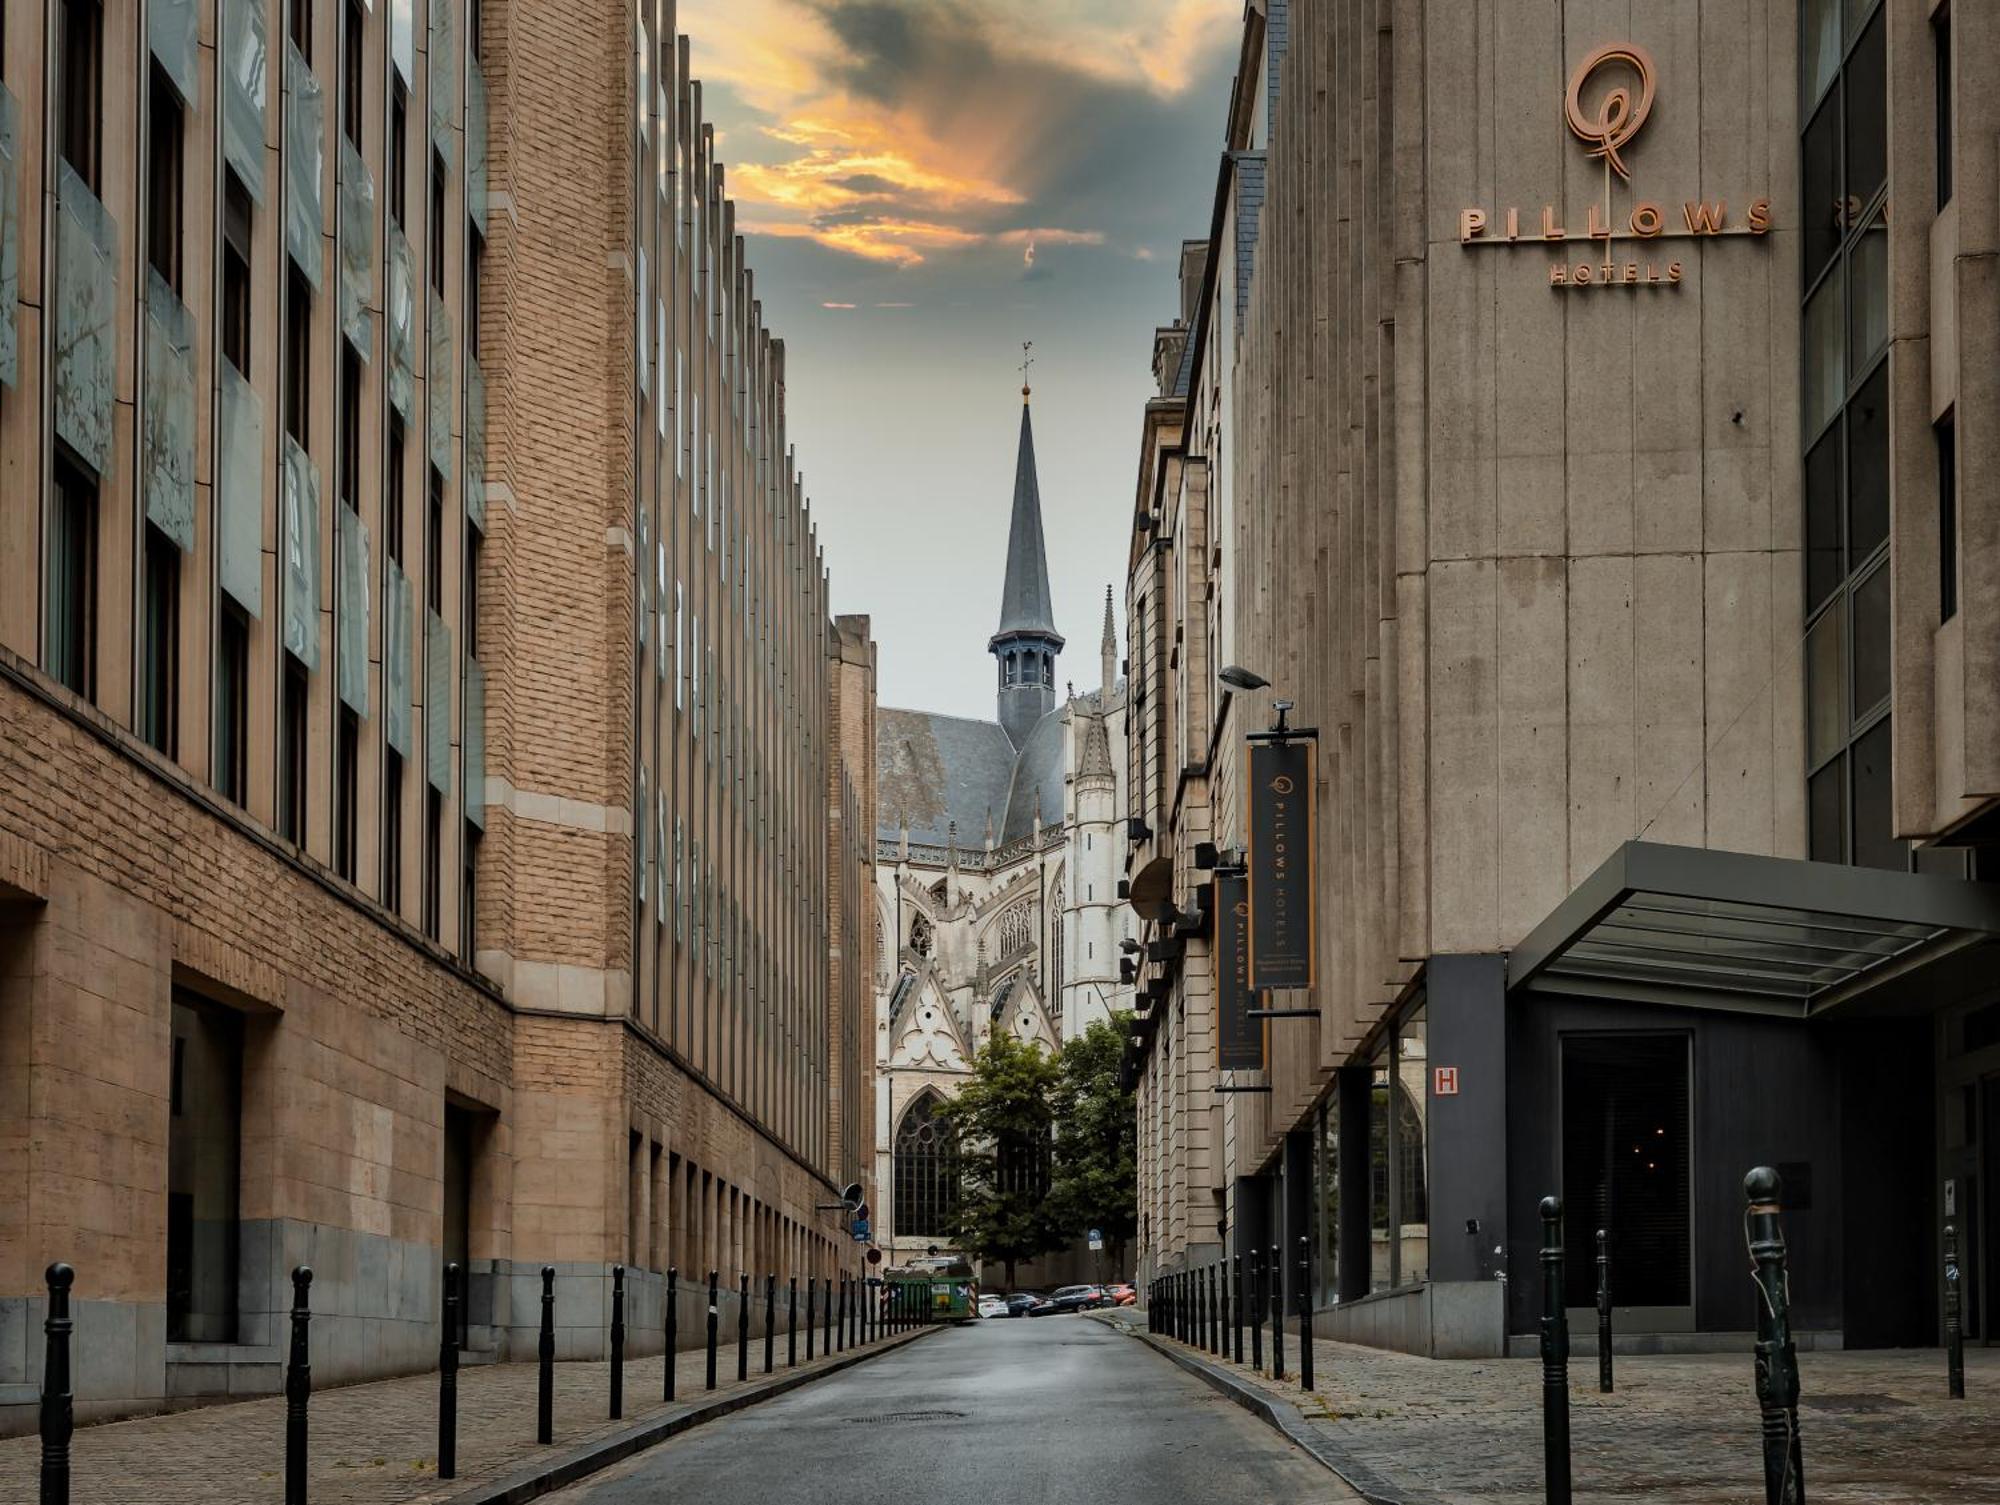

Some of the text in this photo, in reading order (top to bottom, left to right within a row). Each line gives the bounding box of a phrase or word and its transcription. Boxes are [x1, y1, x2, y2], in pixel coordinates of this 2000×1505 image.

[1461, 200, 1773, 242] PILLOWS
[1551, 262, 1681, 285] HOTELS
[1273, 802, 1287, 948] PILLOWS HOTELS
[1236, 922, 1245, 984] PILLOWS
[1439, 1069, 1454, 1092] H
